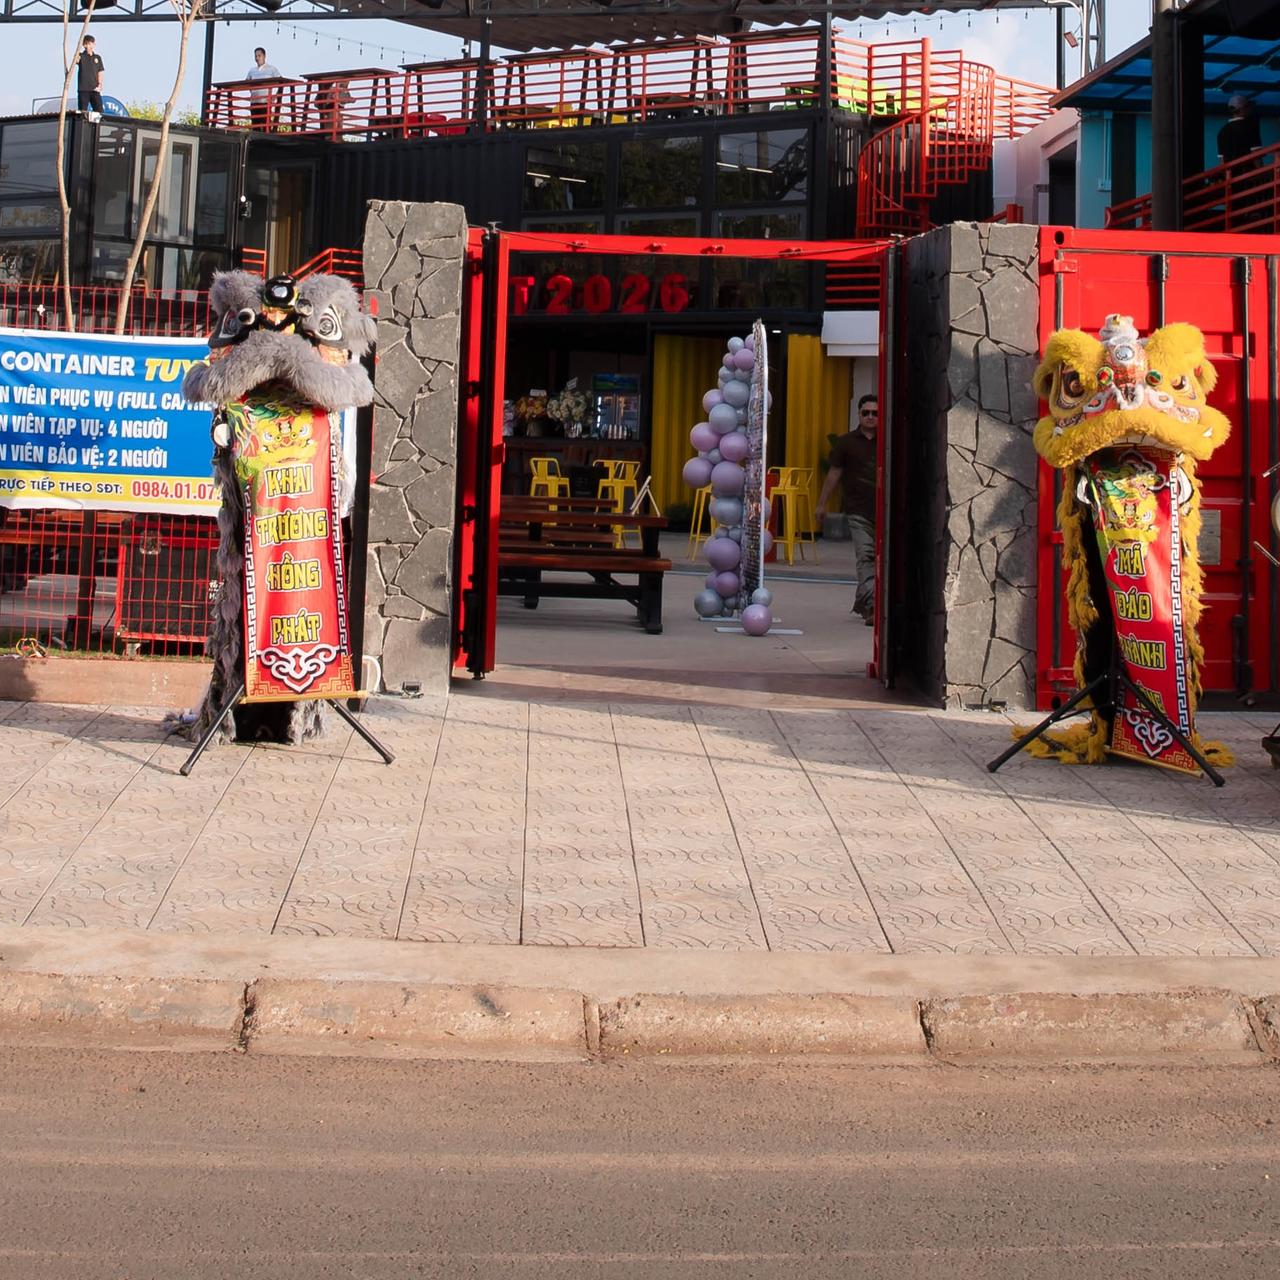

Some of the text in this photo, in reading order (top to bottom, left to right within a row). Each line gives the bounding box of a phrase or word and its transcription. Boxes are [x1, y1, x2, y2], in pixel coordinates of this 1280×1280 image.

[1, 350, 135, 377] CONTAINER
[144, 357, 210, 382] TUY
[13, 384, 47, 405] VIÊN
[50, 387, 90, 411] PHỤC
[94, 389, 114, 412] VỤ
[117, 391, 157, 410] (FULL
[12, 412, 45, 434] VIÊN
[49, 417, 77, 438] TẠP
[81, 418, 104, 440] VỤ:
[107, 419, 118, 438] 4
[121, 416, 168, 439] NGƯỜI
[10, 441, 44, 463] VIÊN
[47, 441, 78, 466] BẢO
[81, 444, 104, 470] VỆ:
[107, 448, 118, 467] 2
[121, 445, 168, 469] NGƯỜI
[30, 475, 55, 492] TIẾP
[60, 482, 93, 493] THEO
[97, 483, 123, 495] SĐT:
[266, 466, 312, 496] KHAI
[256, 510, 327, 545] TRƯƠNG
[268, 553, 320, 591] HỒNG
[1118, 544, 1145, 576] MÃ
[1116, 587, 1152, 621] ĐÁO
[272, 609, 320, 644] PHÁT
